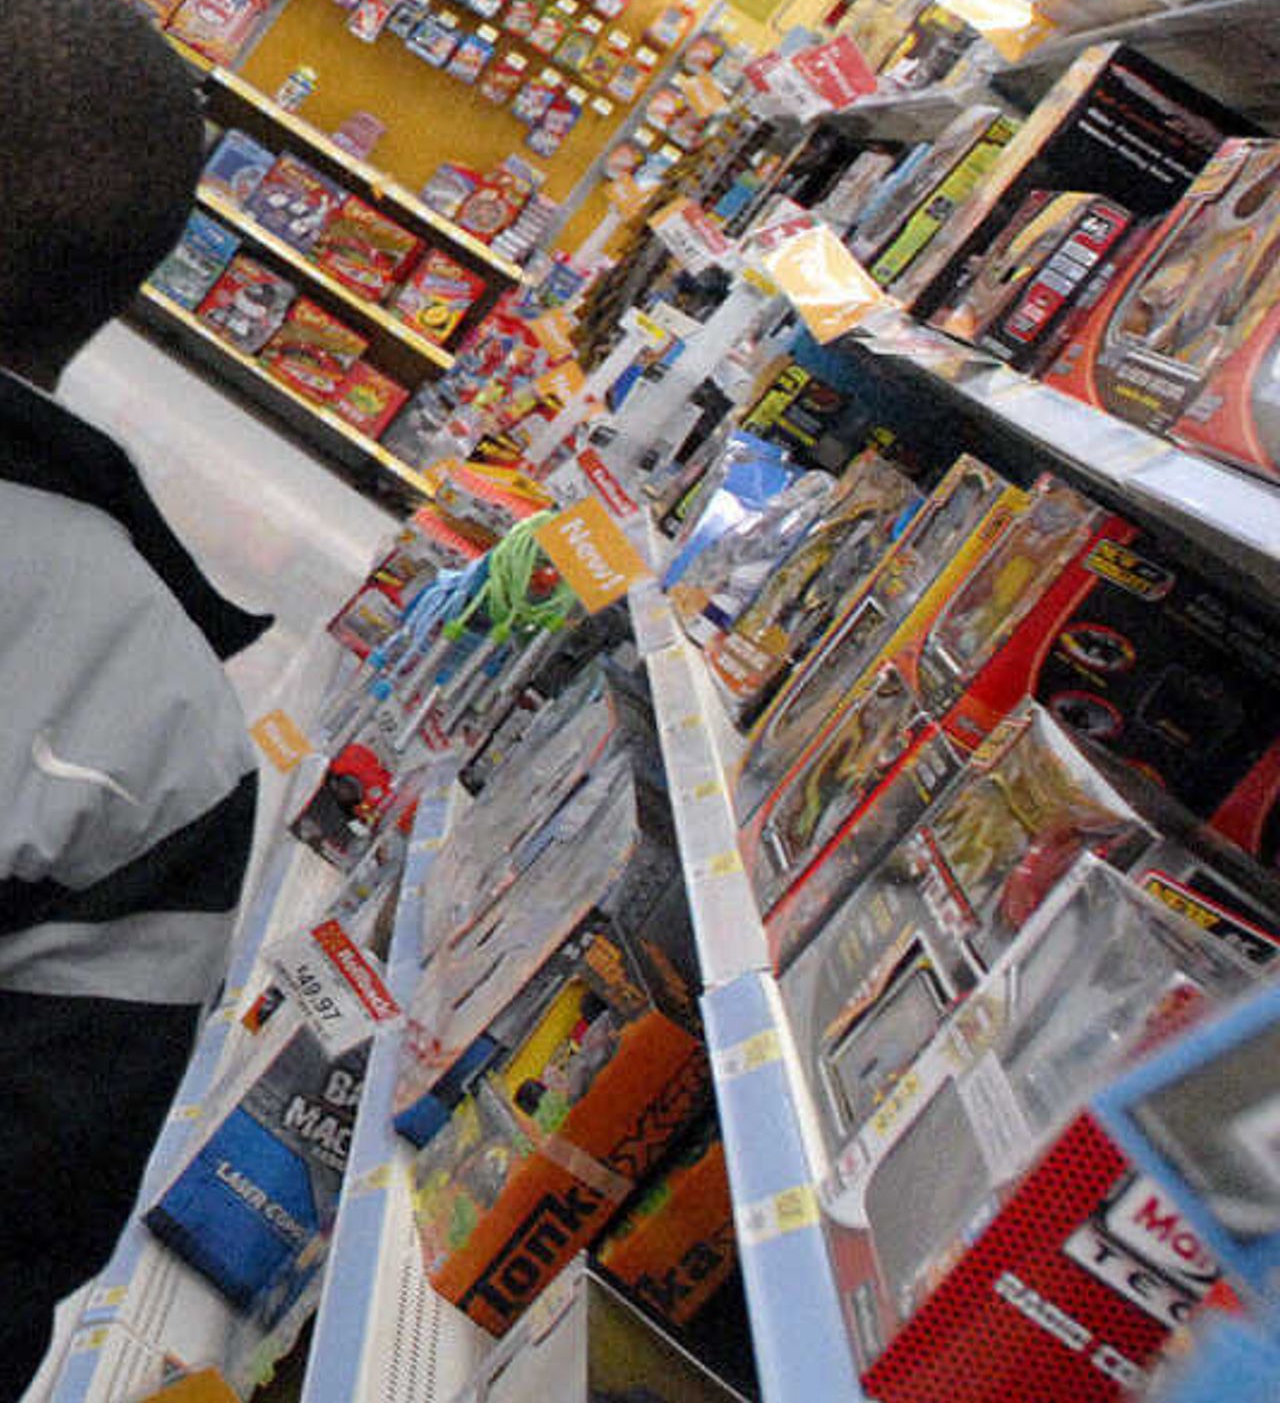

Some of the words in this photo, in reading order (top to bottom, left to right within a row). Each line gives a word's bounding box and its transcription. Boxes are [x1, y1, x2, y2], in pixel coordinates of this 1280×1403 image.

[560, 516, 626, 591] New!
[296, 966, 340, 1022] $49.97
[284, 1096, 352, 1158] MAC
[1131, 1198, 1210, 1269] Mo
[994, 1271, 1092, 1350] RADIO
[1089, 1342, 1146, 1386] CO
